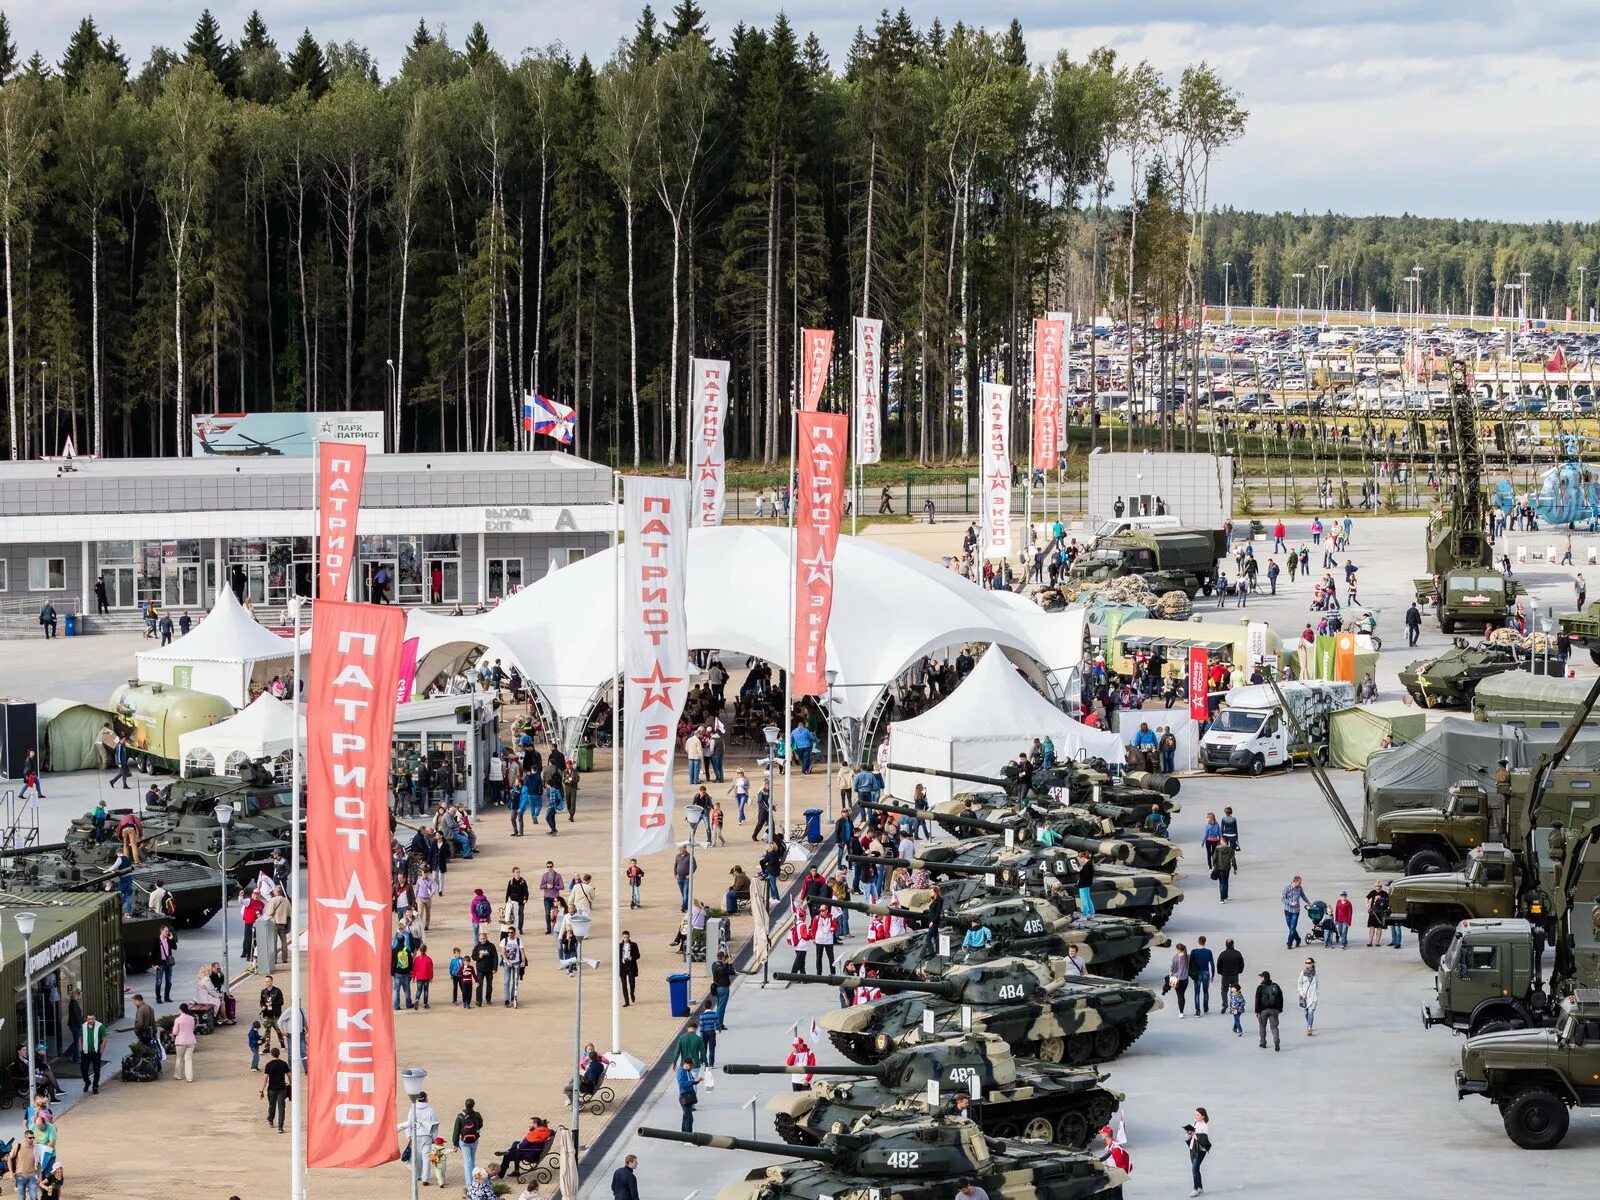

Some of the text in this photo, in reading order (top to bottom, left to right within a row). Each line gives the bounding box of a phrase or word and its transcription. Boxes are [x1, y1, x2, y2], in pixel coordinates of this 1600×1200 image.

[864, 325, 874, 383] ПАТРИОТ
[1041, 327, 1057, 458] ПАТРИОТ ЭКСПО
[337, 431, 379, 439] ПАТРИОТ
[702, 369, 720, 528] ПАТРИОТ ЭКС
[812, 426, 834, 536] ПАТРИОТ
[991, 392, 1005, 546] ПАТРИОТ ЭКСПО
[326, 459, 351, 587] ПАТРИОТ
[485, 508, 531, 520] ВЫХОД
[485, 521, 511, 531] EXIT
[640, 497, 671, 829] ПАТРИОТ ЭКСПО
[1048, 786, 1062, 801] 48
[332, 631, 377, 1126] ПАТРИОТ ЭКСПО
[1039, 859, 1080, 872] 486
[1024, 920, 1043, 933] 485
[27, 930, 78, 976] РМИЯ РОССИИ
[999, 984, 1025, 999] 484
[887, 1151, 919, 1169] 482
